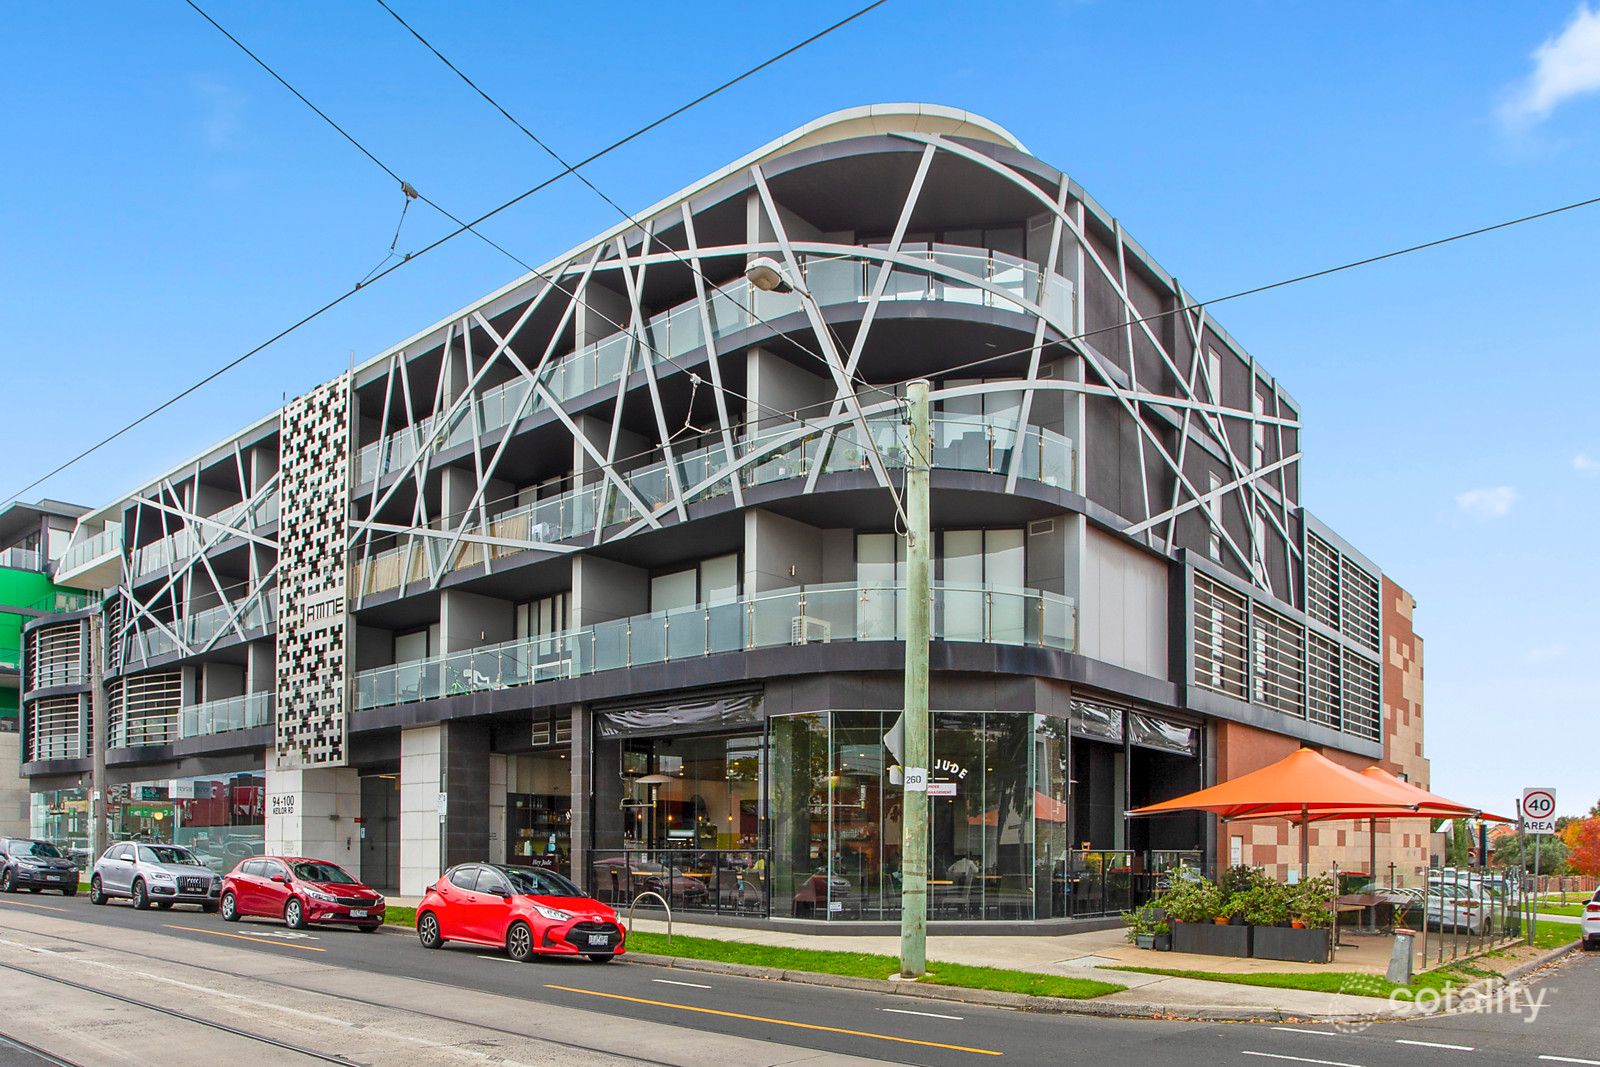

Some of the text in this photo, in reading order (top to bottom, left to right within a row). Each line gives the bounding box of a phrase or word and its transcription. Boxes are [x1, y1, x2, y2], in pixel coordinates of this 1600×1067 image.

[934, 759, 968, 779] JUDE
[906, 775, 921, 784] 260
[272, 795, 294, 807] 94-100
[1528, 799, 1550, 811] 40
[1524, 821, 1553, 830] AREA
